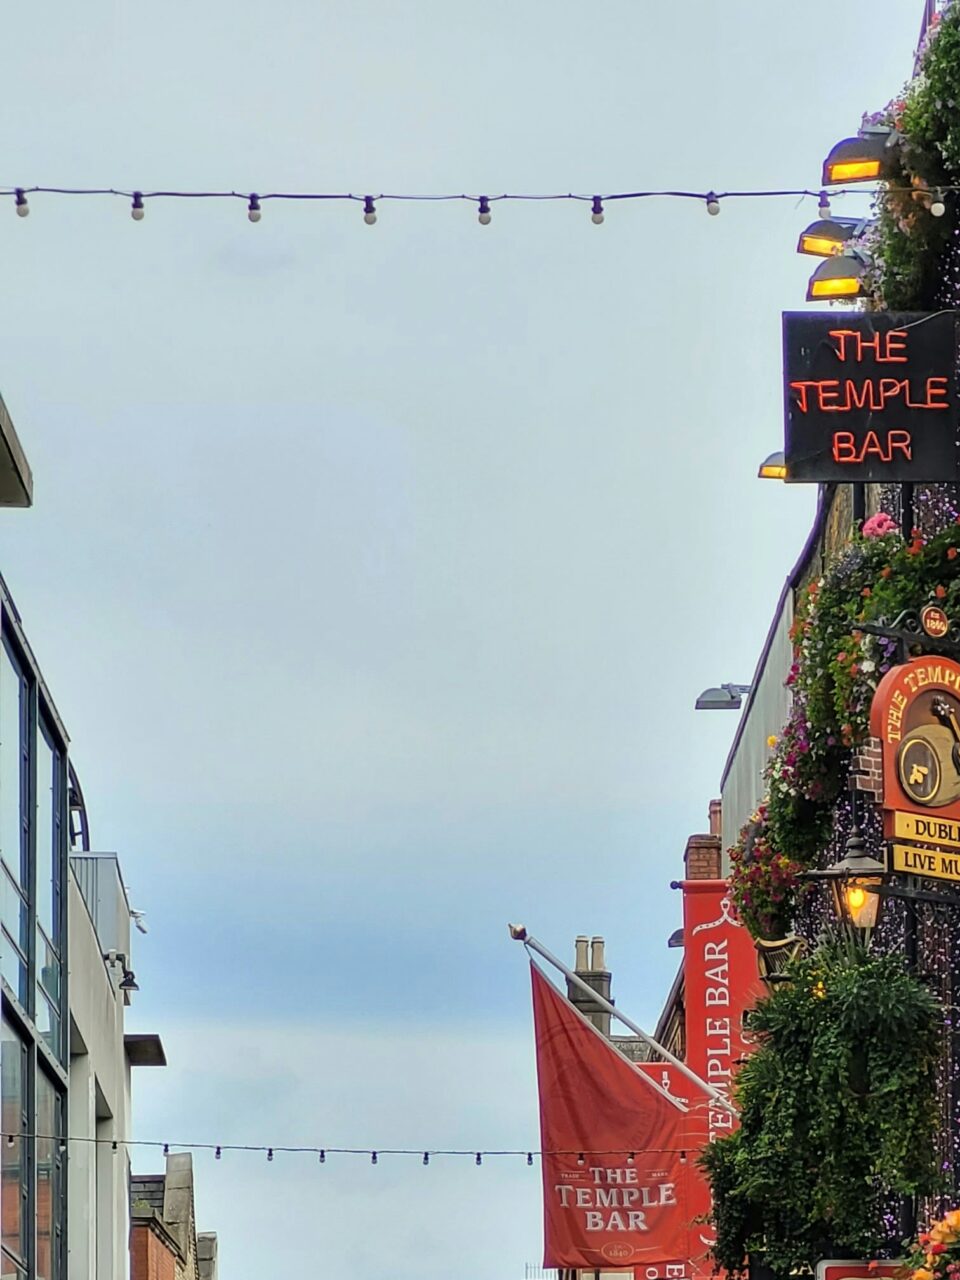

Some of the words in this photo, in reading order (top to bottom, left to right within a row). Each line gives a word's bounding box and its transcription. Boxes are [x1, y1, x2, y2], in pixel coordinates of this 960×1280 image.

[829, 330, 908, 362] THE
[790, 377, 949, 412] TEMPLE
[832, 430, 912, 463] BAR
[888, 690, 907, 744] THE
[904, 852, 936, 871] LIVE
[705, 938, 730, 1007] BAR
[589, 1167, 638, 1184] THE
[555, 1183, 677, 1208] TEMPLE
[585, 1211, 649, 1232] BAR
